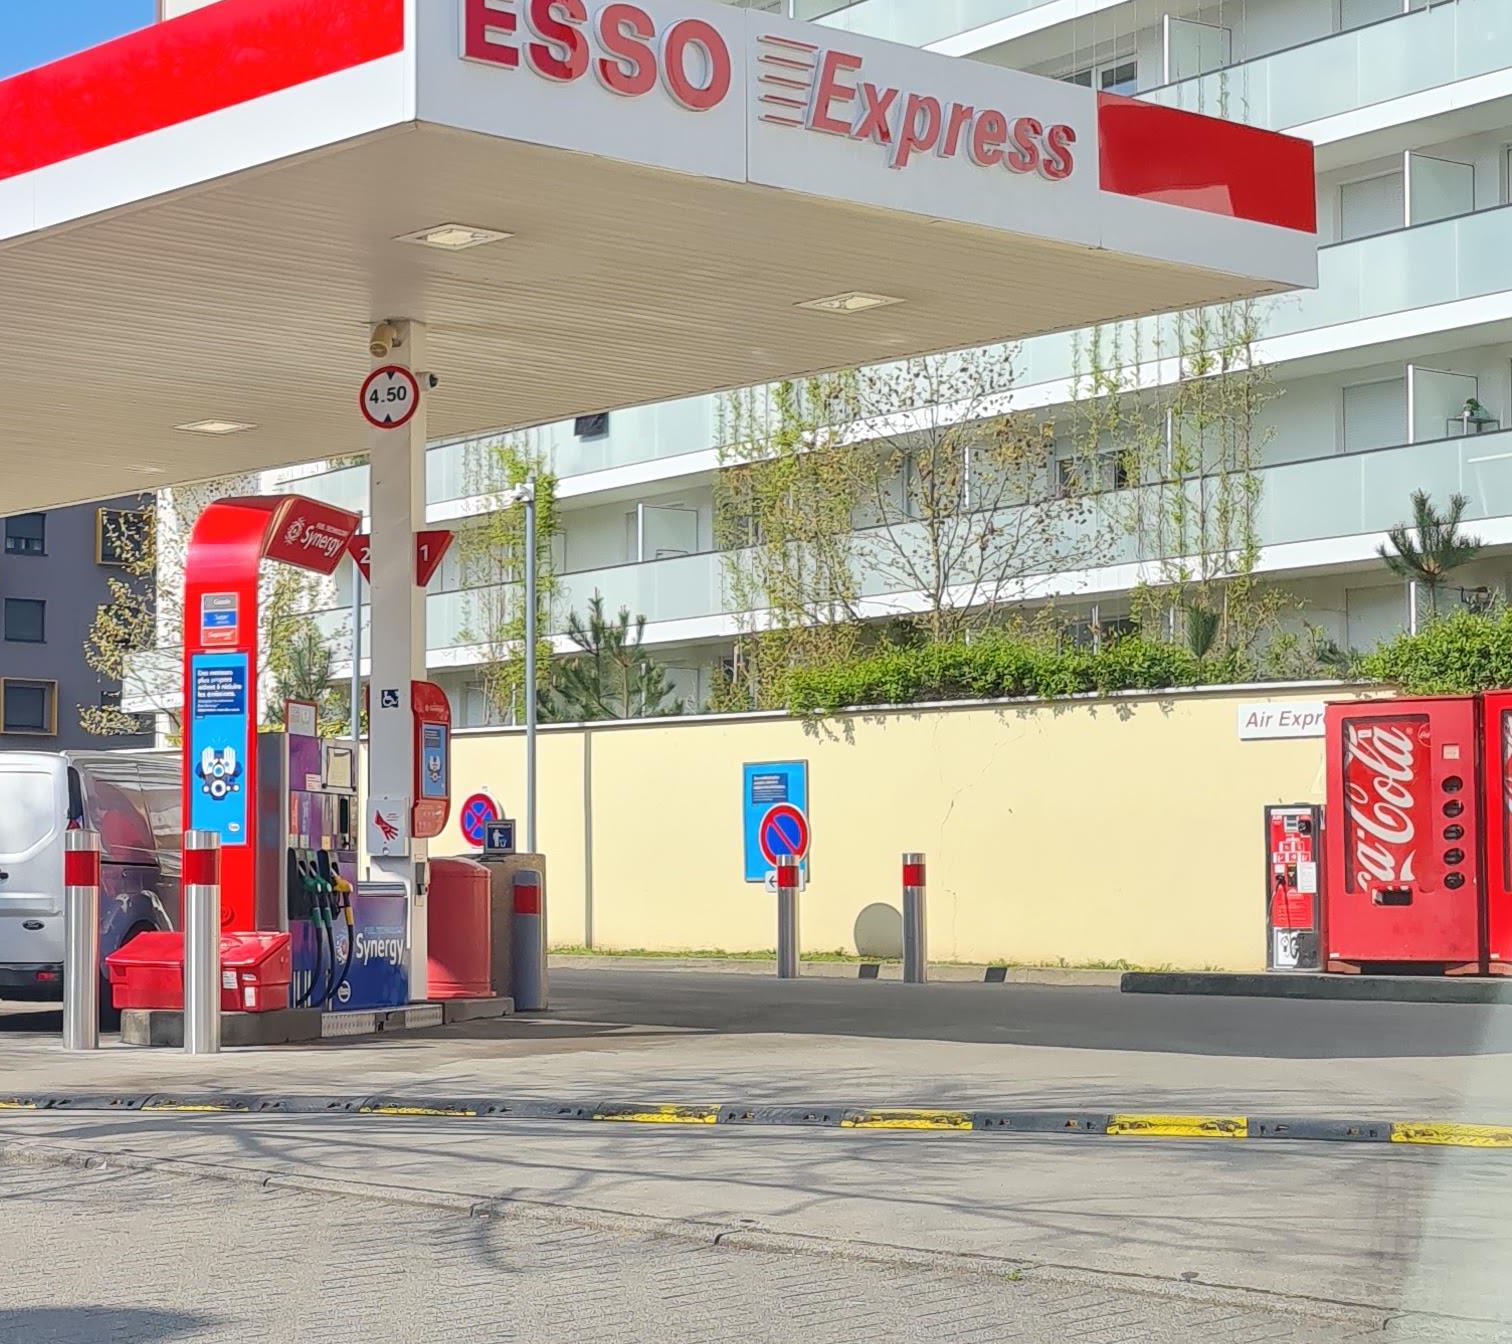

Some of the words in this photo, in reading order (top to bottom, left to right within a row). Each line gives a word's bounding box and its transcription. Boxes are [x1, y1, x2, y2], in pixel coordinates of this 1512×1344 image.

[805, 49, 1076, 181] Express
[369, 385, 407, 404] 4.50
[300, 525, 344, 558] Synergy
[360, 547, 371, 564] 2
[419, 544, 429, 562] 1
[1245, 711, 1274, 728] Air
[1278, 710, 1326, 730] Expr
[356, 932, 404, 966] Synergy
